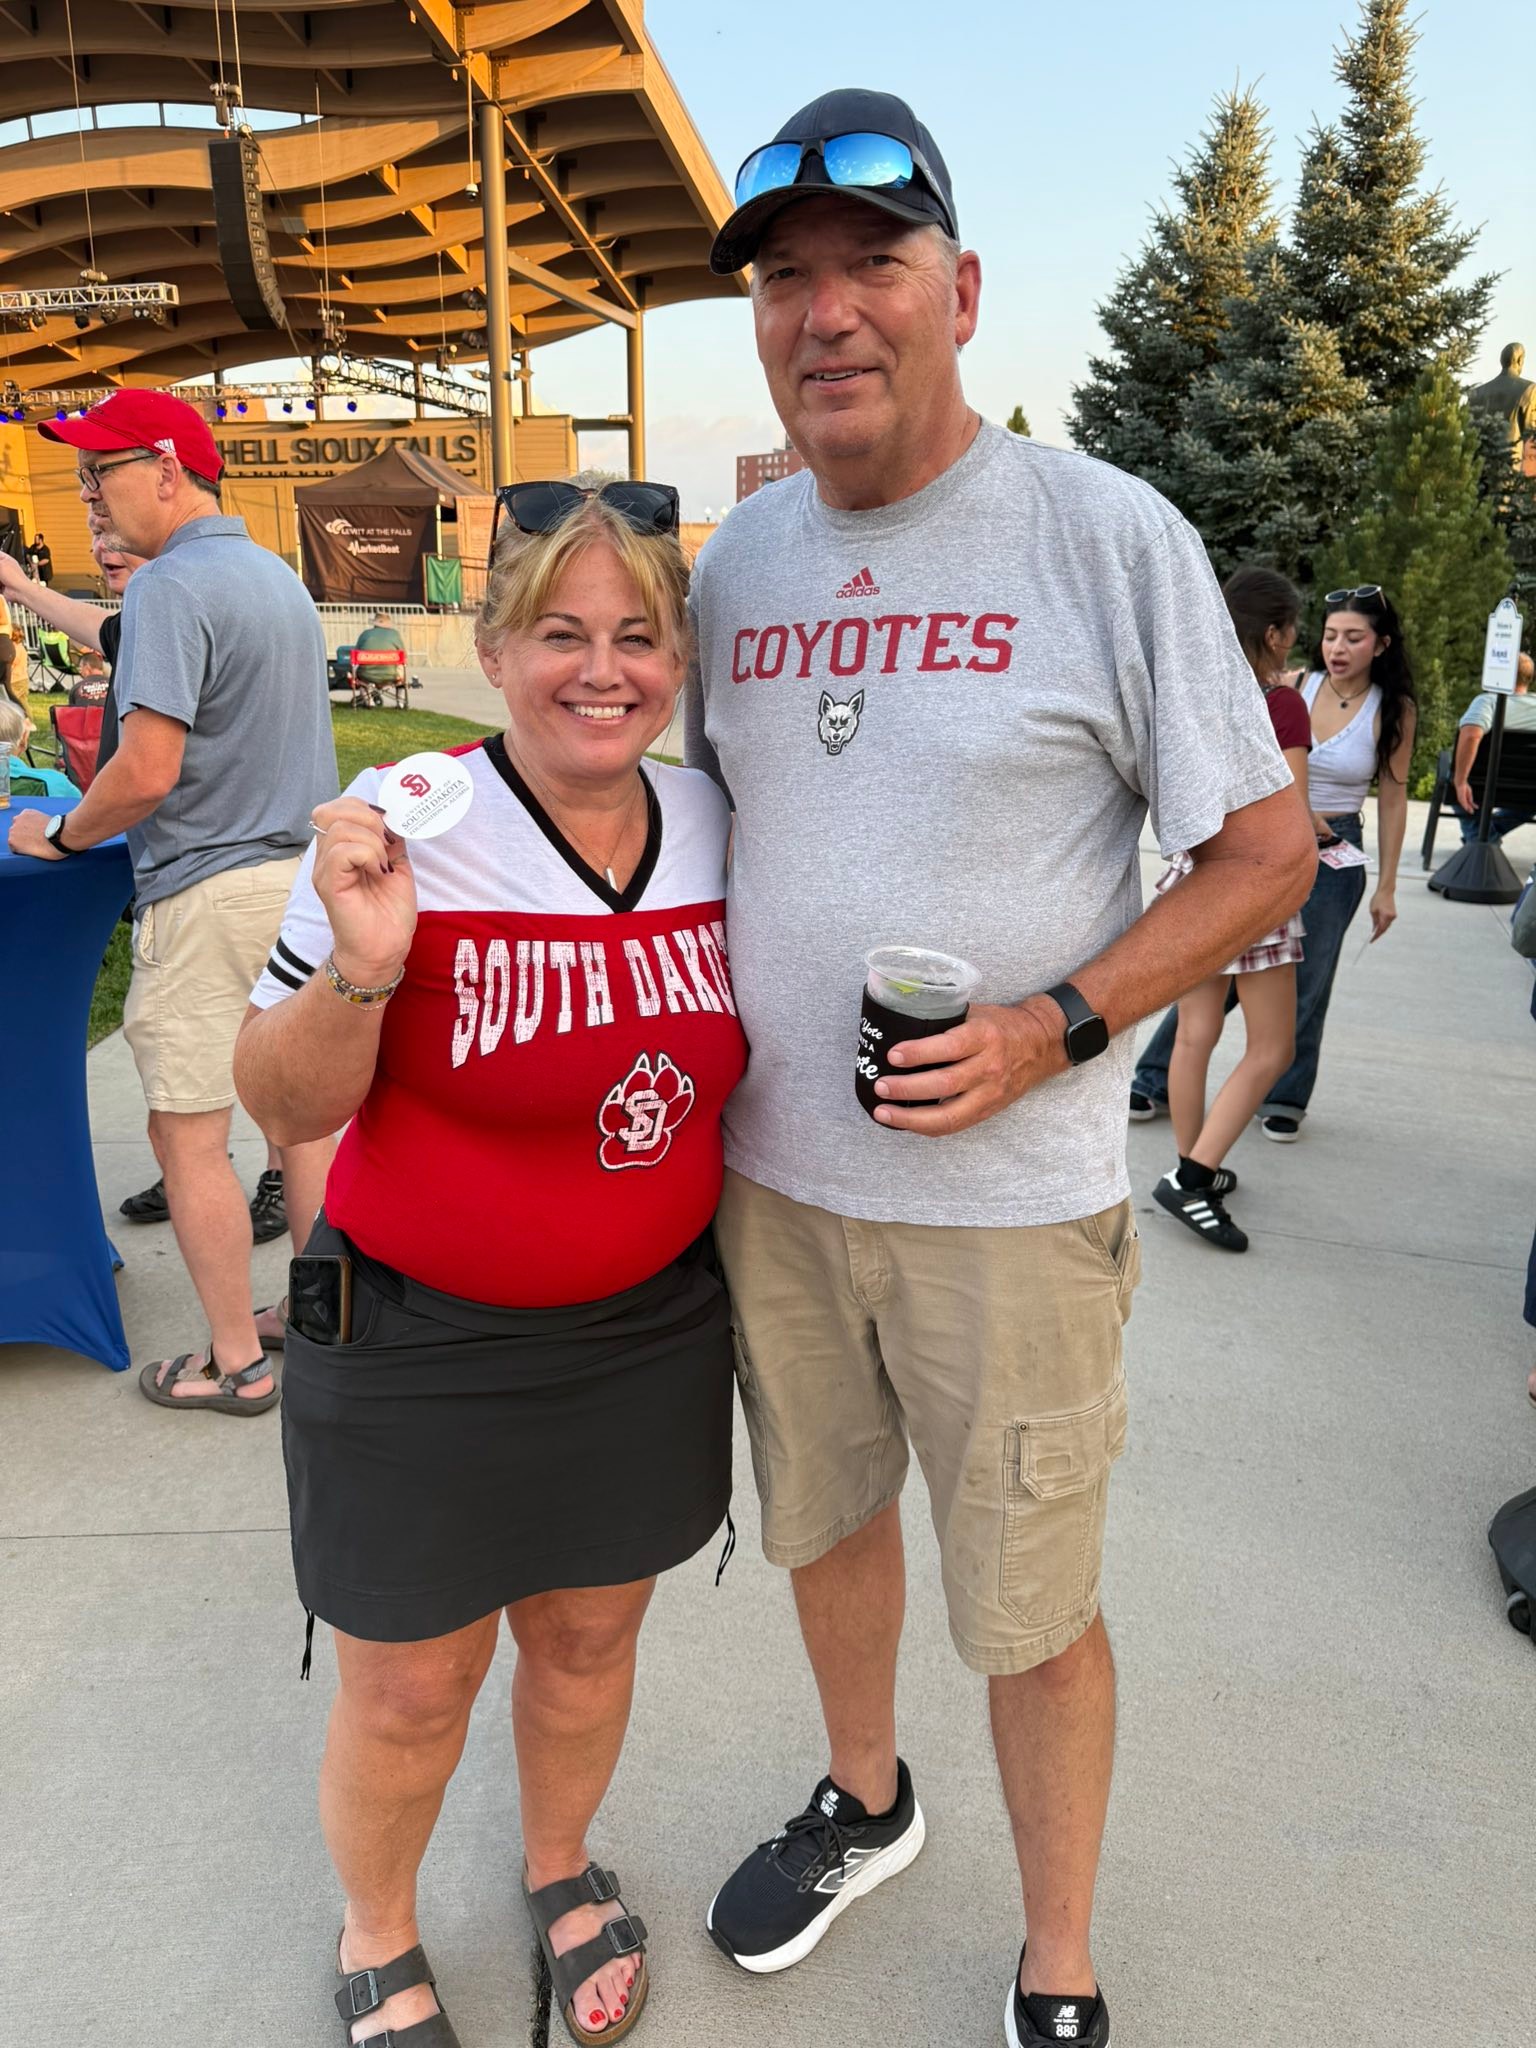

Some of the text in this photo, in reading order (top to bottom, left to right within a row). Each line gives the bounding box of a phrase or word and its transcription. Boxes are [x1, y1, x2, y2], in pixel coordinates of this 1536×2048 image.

[291, 437, 382, 464] SIOUX
[366, 528, 375, 536] AT
[376, 528, 390, 536] THE
[391, 528, 413, 537] FALLS
[835, 584, 881, 599] adidas
[731, 612, 1020, 685] COYOTES
[401, 779, 465, 831] SOUTH DAKOTA
[451, 920, 739, 1070] SOUTH DAKO
[820, 1799, 834, 1818] 880
[1056, 2024, 1077, 2037] 880
